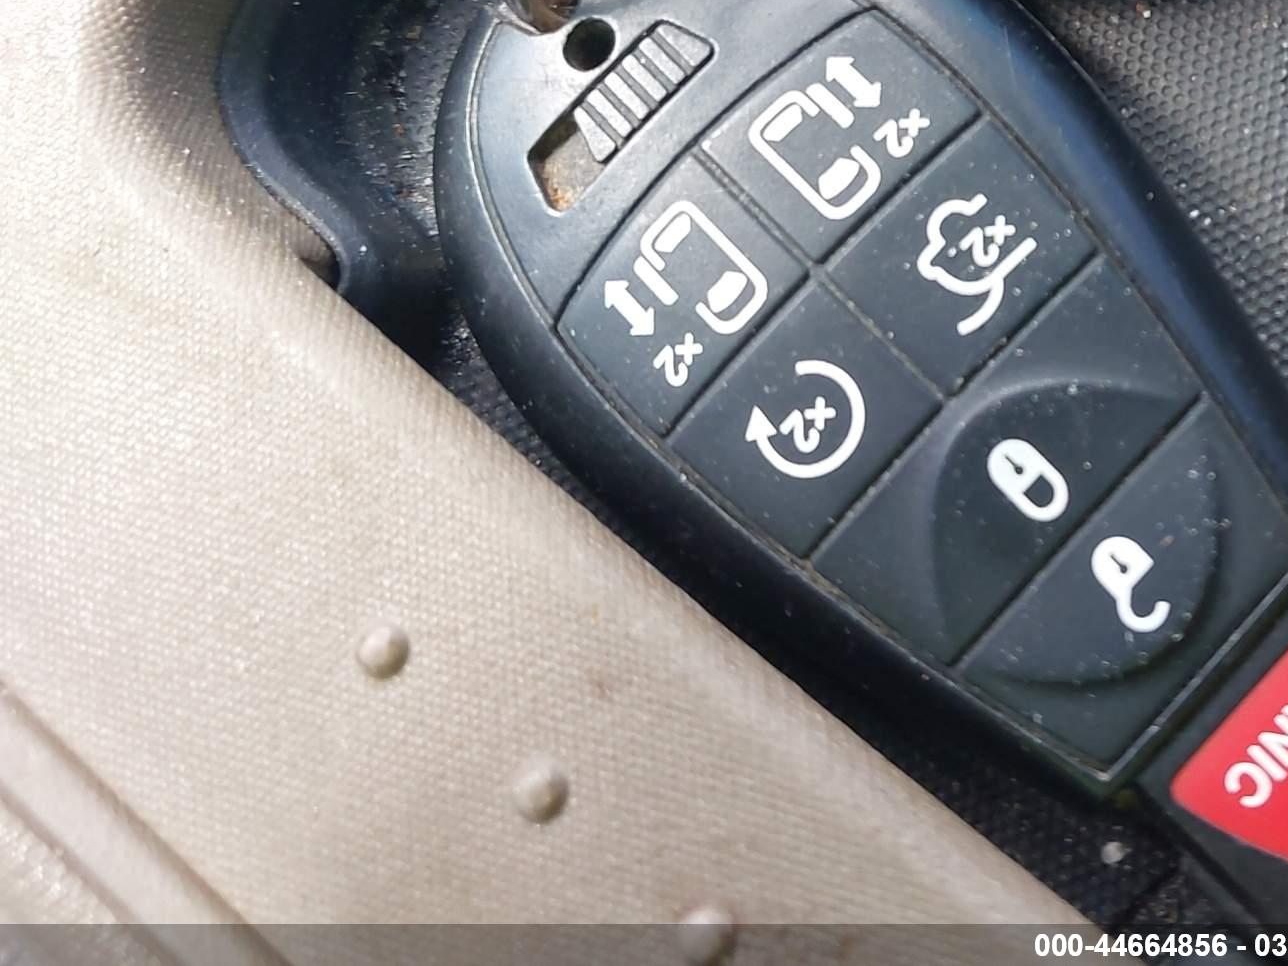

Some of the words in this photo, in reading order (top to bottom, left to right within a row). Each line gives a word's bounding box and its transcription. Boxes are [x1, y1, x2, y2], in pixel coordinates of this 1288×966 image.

[873, 107, 930, 158] x2
[959, 215, 1016, 267] x2
[653, 332, 703, 387] x2
[779, 396, 836, 453] x2
